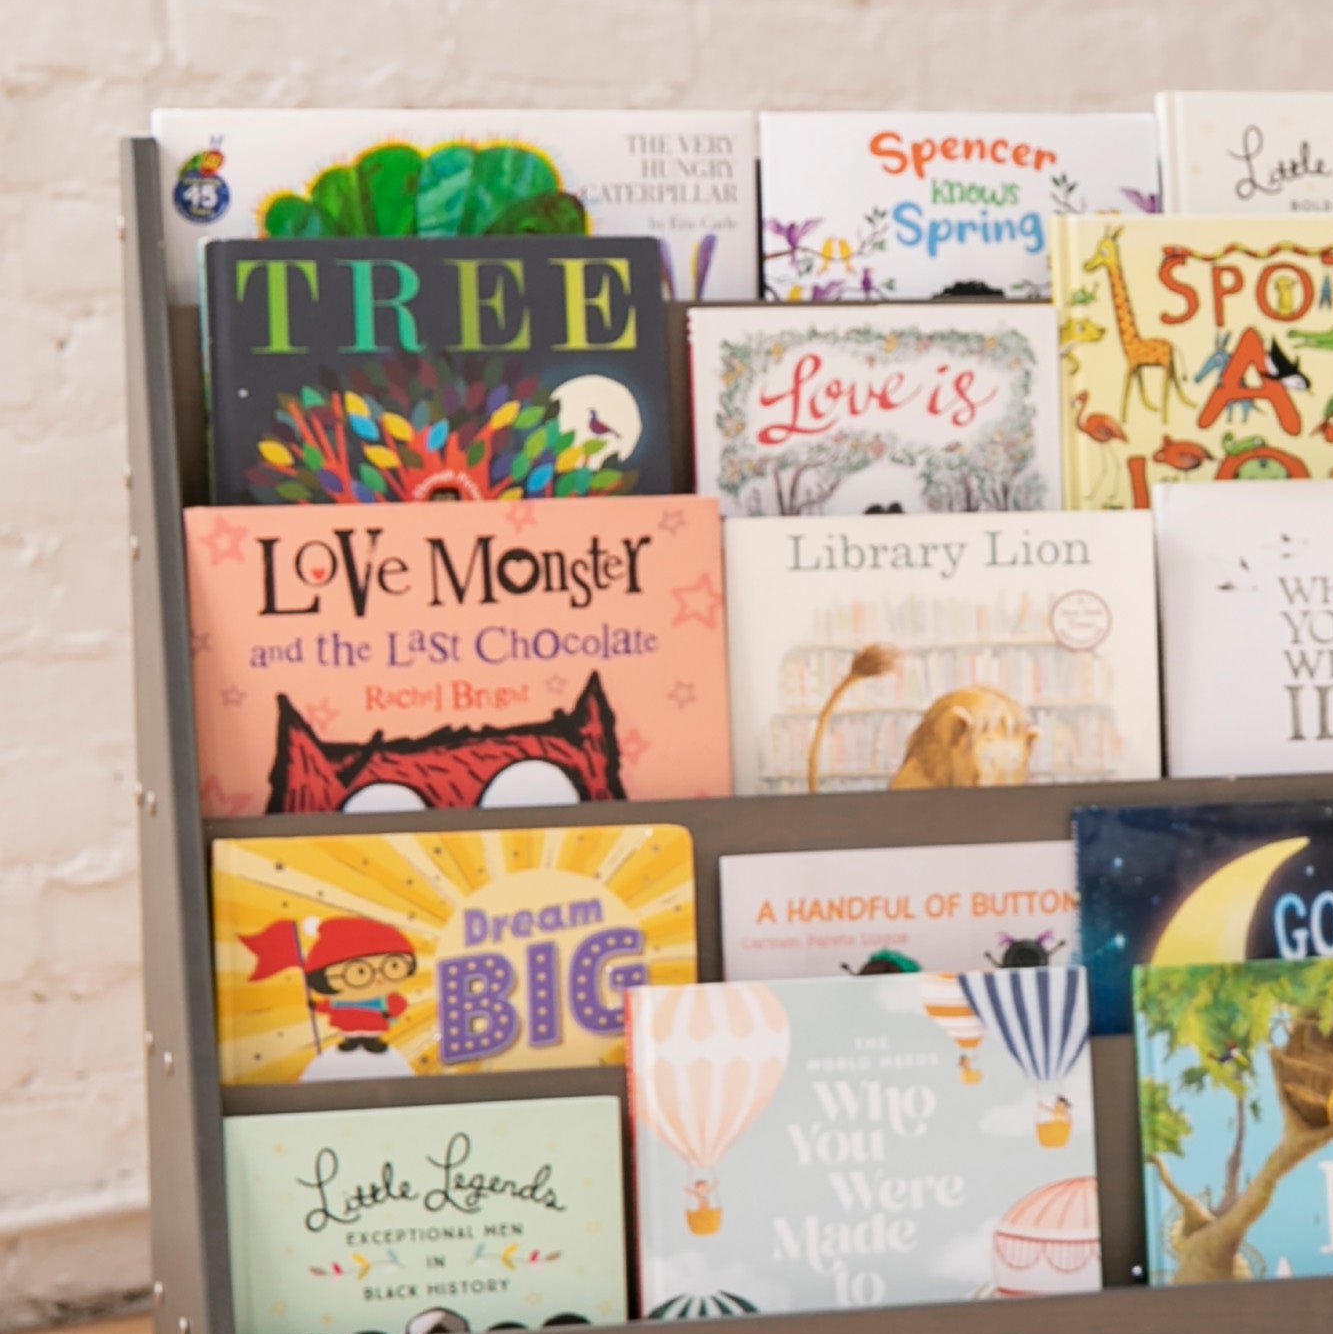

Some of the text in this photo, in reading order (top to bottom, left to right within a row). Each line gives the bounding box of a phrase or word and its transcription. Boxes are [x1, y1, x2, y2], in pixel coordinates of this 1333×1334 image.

[626, 133, 735, 154] THE VERY
[869, 132, 1057, 179] Spencer
[892, 200, 1045, 257] Spring
[235, 257, 638, 354] TREE
[757, 352, 999, 445] Love is
[1197, 326, 1302, 436] A
[787, 528, 1092, 579] Library Lion
[249, 637, 304, 668] and
[315, 631, 373, 668] the
[364, 682, 443, 713] Rachel
[463, 898, 605, 948] Dream
[755, 900, 777, 924] A
[785, 895, 917, 923] HANDFUL
[924, 892, 961, 919] OF
[436, 927, 648, 1065] BIG
[812, 1079, 938, 1139] Who
[785, 1122, 886, 1167] You
[296, 1131, 567, 1233] Little Legends
[827, 1168, 966, 1212] Were
[345, 1222, 525, 1248] EXCEPTIONAL MEN
[772, 1212, 919, 1275] Made
[425, 1254, 447, 1269] IN
[362, 1277, 511, 1303] BLACK HISTORY
